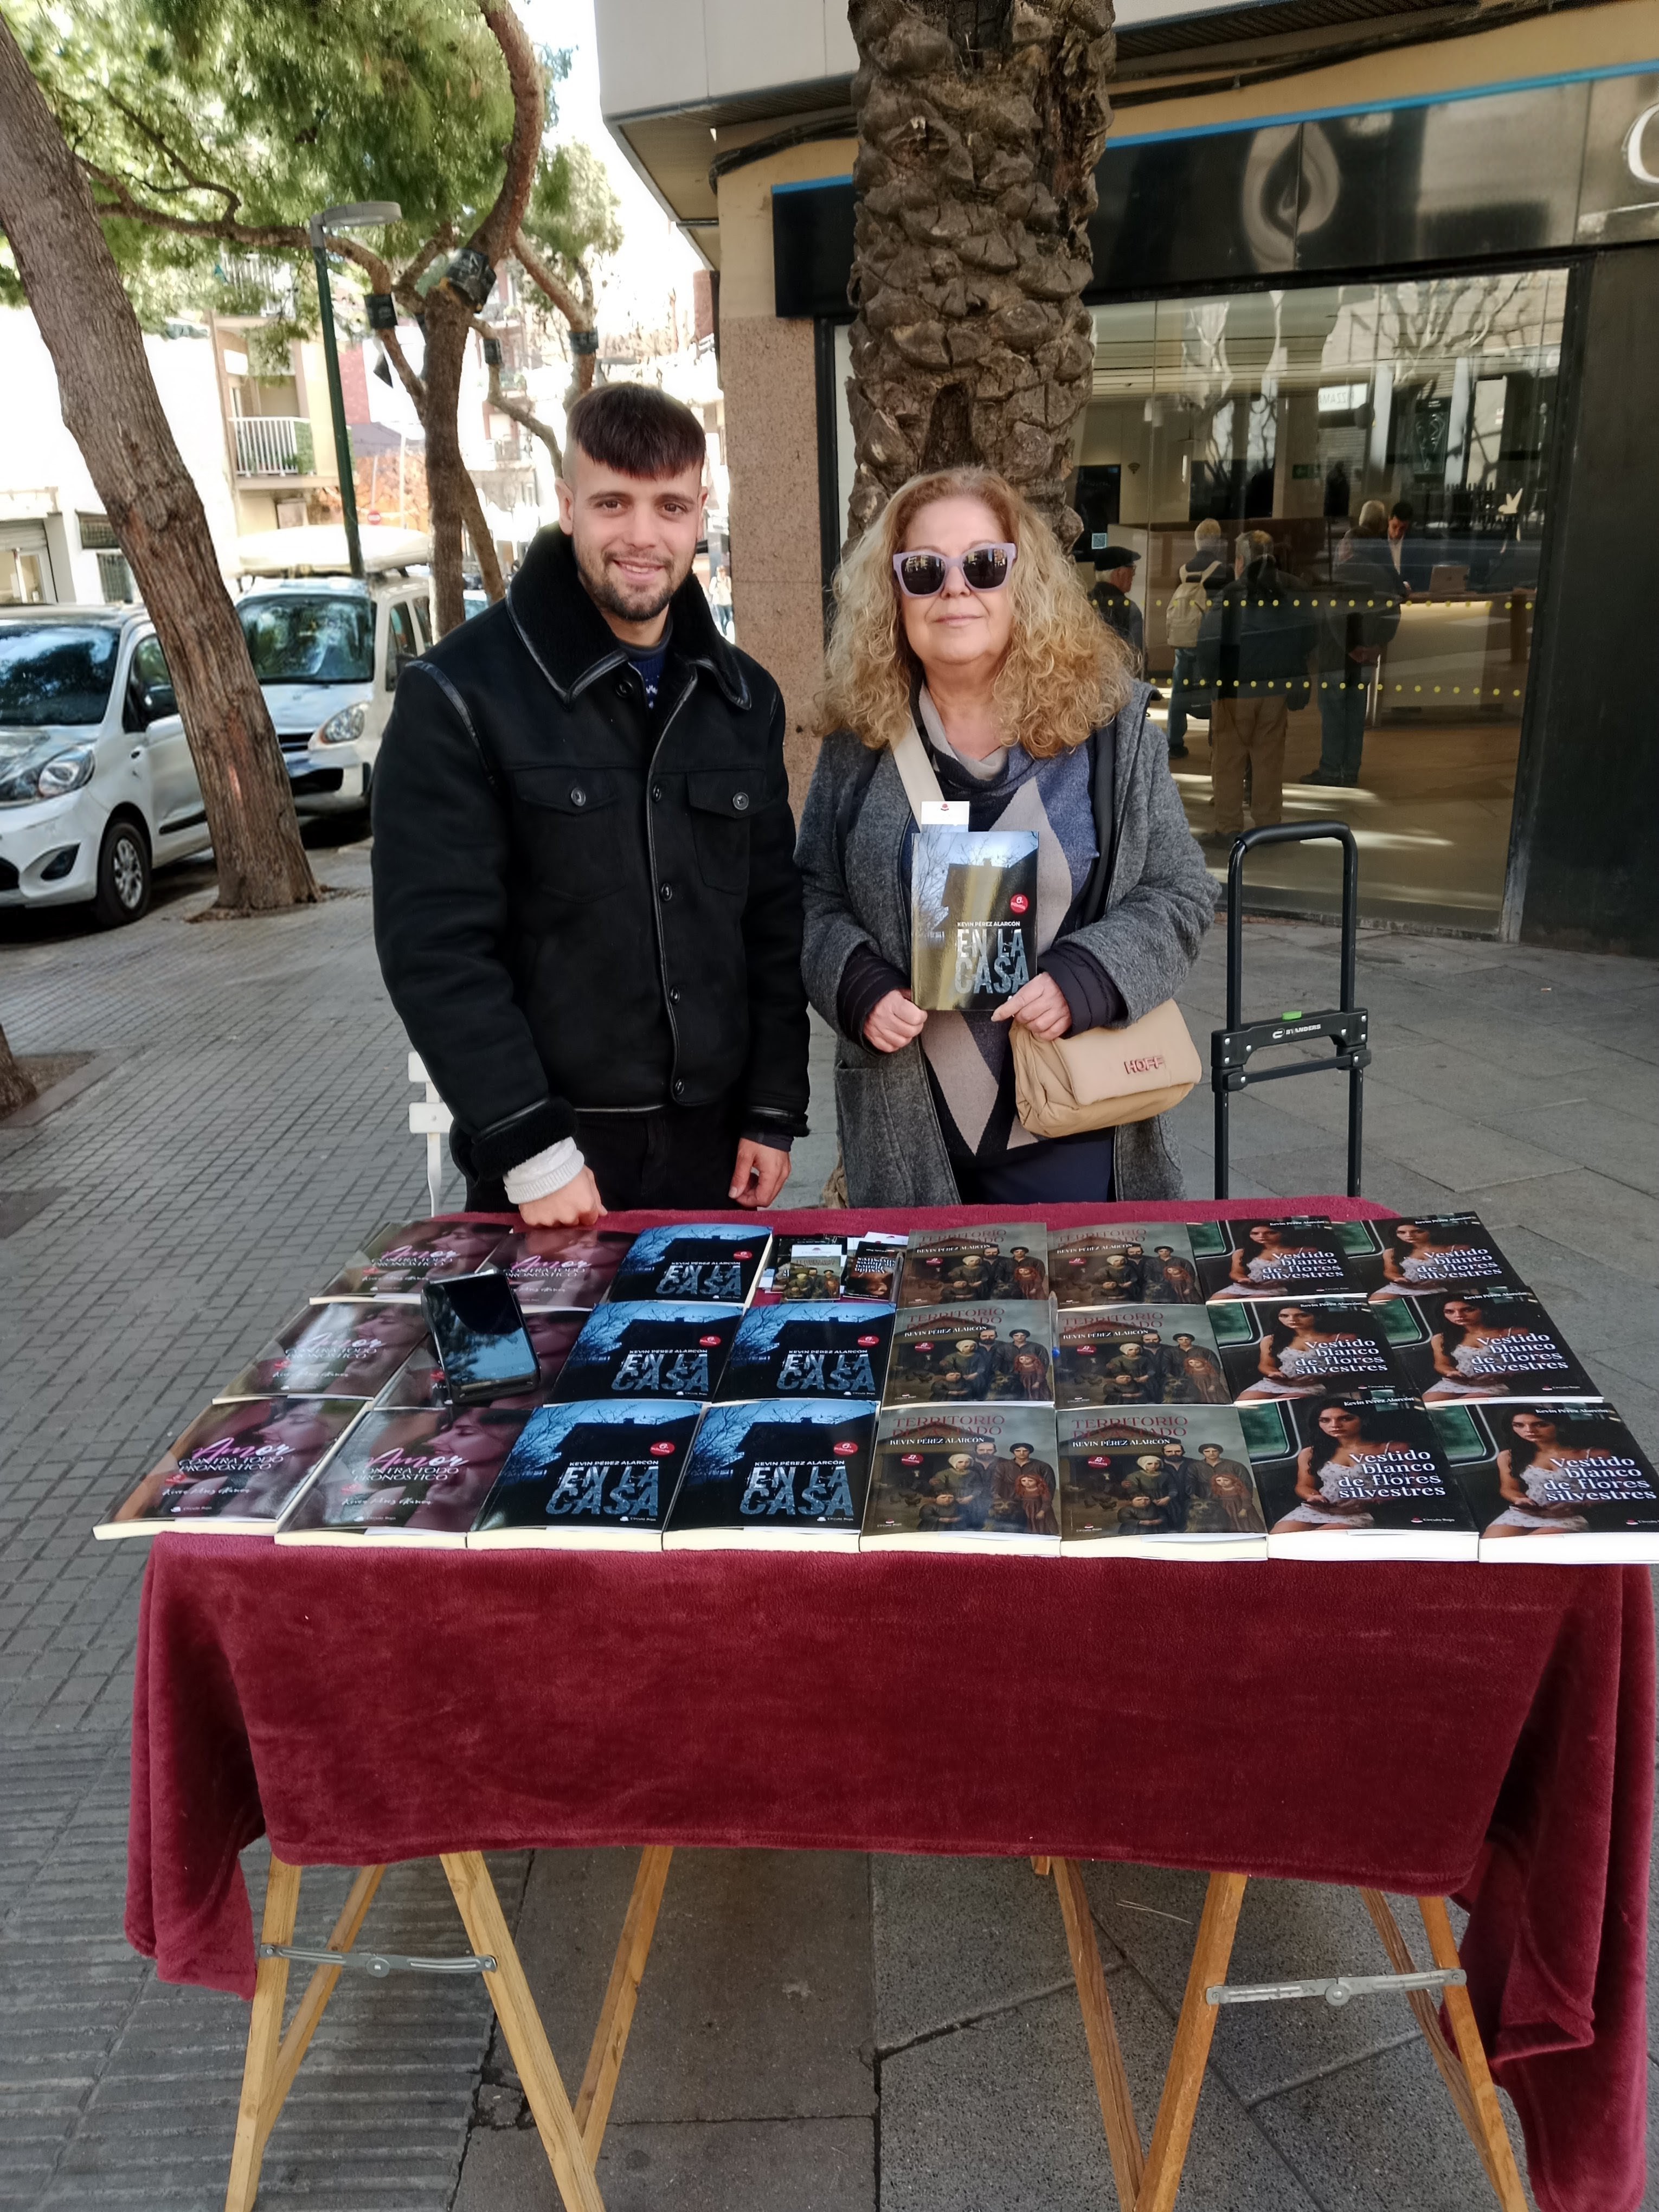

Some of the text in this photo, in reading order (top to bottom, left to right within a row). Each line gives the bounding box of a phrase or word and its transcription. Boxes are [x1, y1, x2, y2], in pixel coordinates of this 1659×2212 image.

[956, 929, 1025, 957] EN LA
[955, 956, 1029, 994] CASA
[1124, 1055, 1164, 1074] HOFF
[921, 1229, 1006, 1242] TERRITORIO
[1059, 1229, 1146, 1242] TERRITORIO
[1272, 1251, 1334, 1259] Vestido
[1424, 1248, 1488, 1259] Vestido
[1434, 1255, 1493, 1265] blanco
[1281, 1258, 1338, 1266] blanco
[1417, 1261, 1498, 1274] de flores
[665, 1265, 741, 1279] EN LA
[1262, 1265, 1341, 1274] de flores
[1262, 1271, 1344, 1280] silvestres
[1418, 1268, 1502, 1280] silvestres
[655, 1277, 741, 1295] CASA
[909, 1308, 1005, 1322] TERRITORIO
[1063, 1312, 1163, 1325] TERRITORIO
[1305, 1338, 1375, 1349] Vestido
[1476, 1333, 1550, 1347] Vestido
[1316, 1347, 1379, 1357] blanco
[1489, 1342, 1556, 1354] blanco
[621, 1354, 708, 1371] EN LA
[782, 1354, 869, 1370] EN LA
[1295, 1355, 1385, 1367] de flores
[1471, 1351, 1563, 1365] de flores
[1296, 1363, 1388, 1374] silvestres
[1474, 1360, 1568, 1374] silvestres
[611, 1369, 709, 1392] CASA
[776, 1368, 876, 1391] CASA
[894, 1416, 1005, 1427] TERRITORIO
[1072, 1416, 1188, 1429] TERRITORIO
[192, 1437, 295, 1460] Amor
[366, 1448, 469, 1471] Amor
[1349, 1450, 1431, 1464] Vestido
[1549, 1456, 1635, 1468] Vestido
[1362, 1462, 1435, 1475] blanco
[1565, 1467, 1642, 1479] blanco
[557, 1466, 659, 1488] EN LA
[745, 1465, 846, 1488] EN LA
[1339, 1473, 1442, 1488] de flores
[1544, 1478, 1650, 1490] de flores
[1339, 1486, 1446, 1499] silvestres
[1546, 1488, 1657, 1501] silvestres
[546, 1487, 658, 1516] CASA
[740, 1487, 853, 1516] CASA
